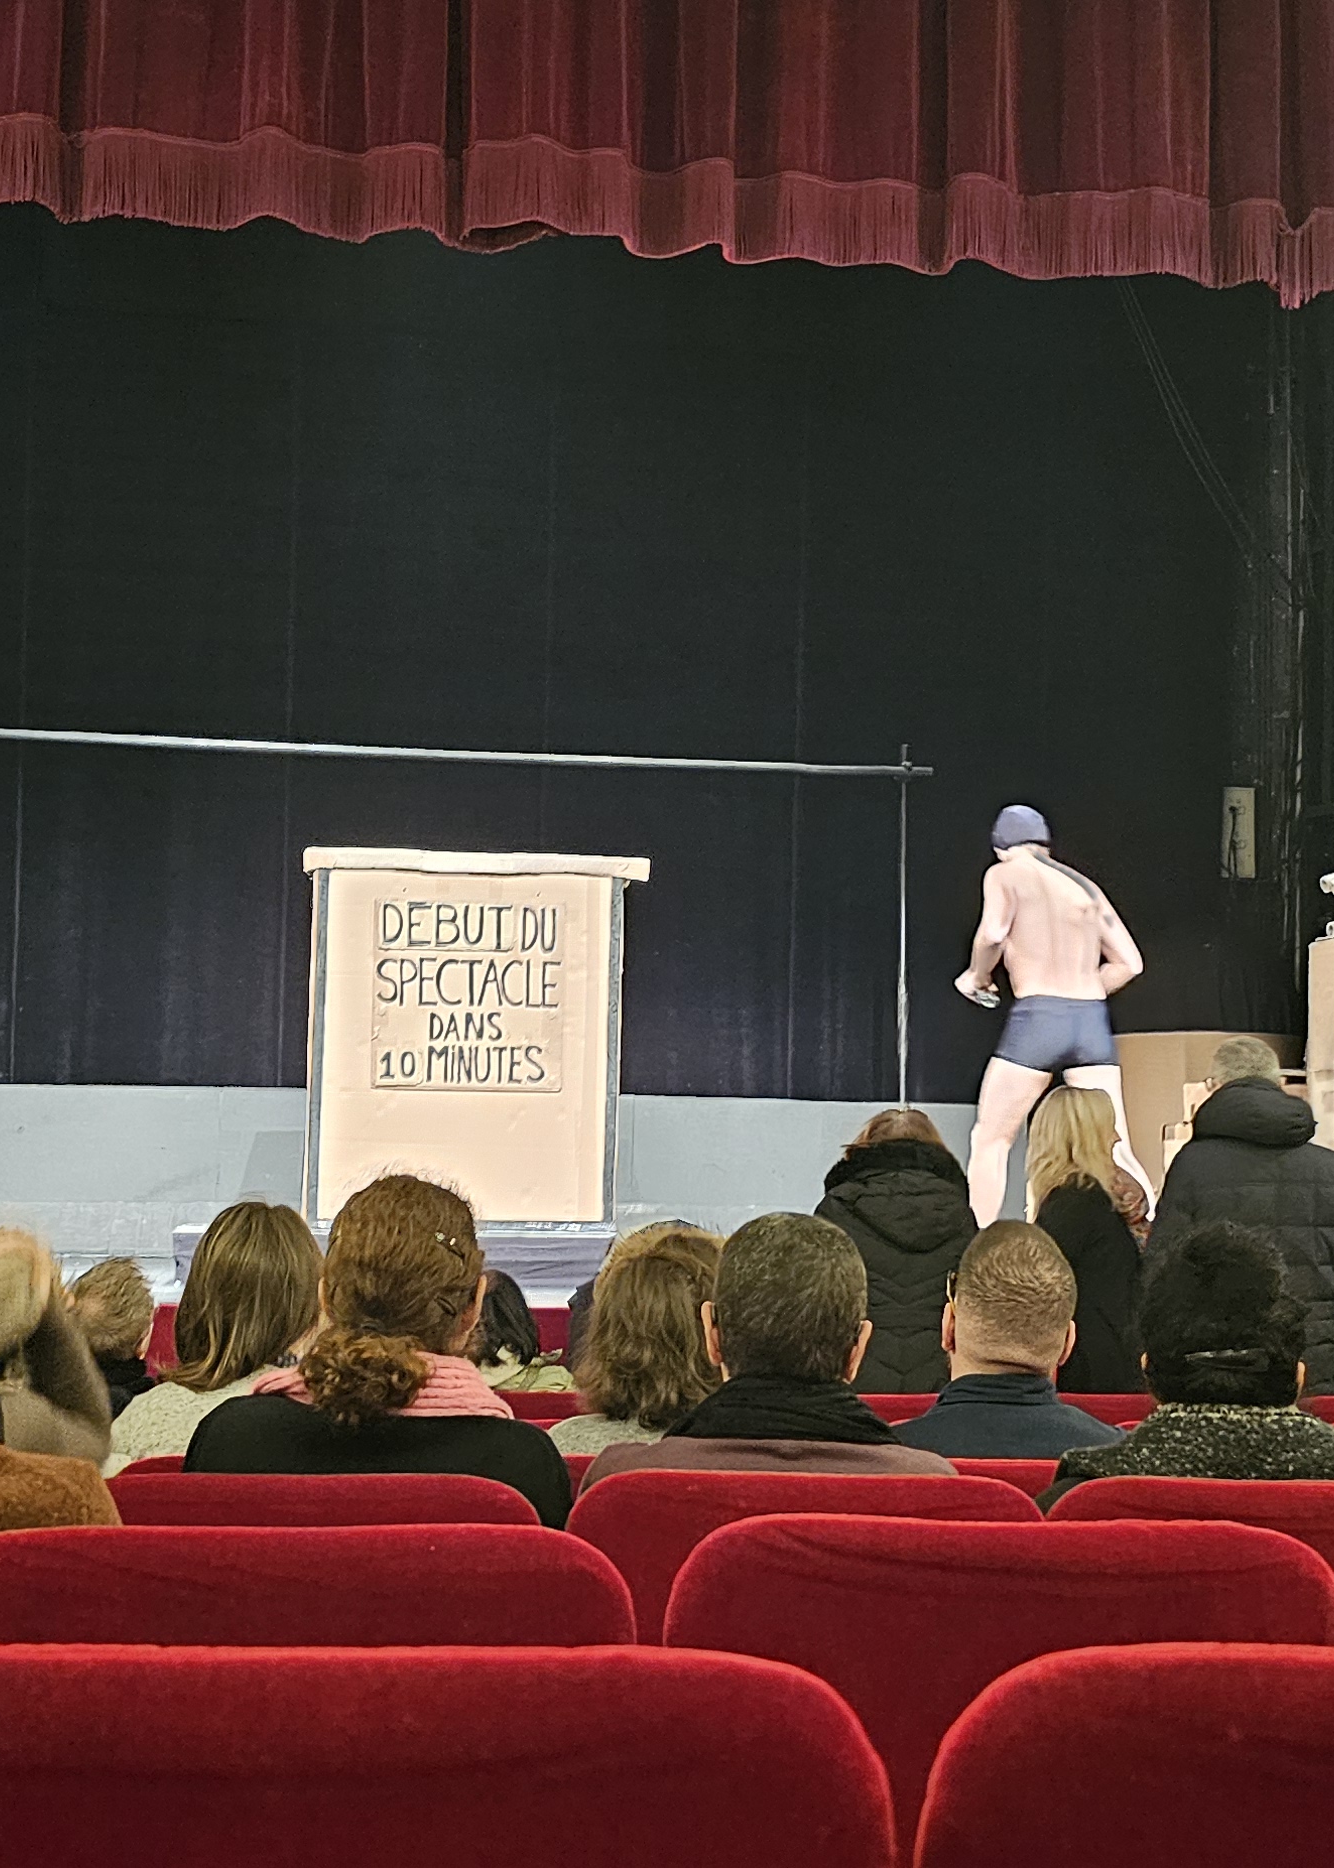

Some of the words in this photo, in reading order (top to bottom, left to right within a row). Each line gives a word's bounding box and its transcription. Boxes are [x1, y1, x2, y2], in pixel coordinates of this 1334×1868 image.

[520, 907, 557, 952] DU
[376, 957, 562, 1008] SPECTACLE
[429, 1012, 503, 1041] DANS
[379, 1051, 417, 1080] 10
